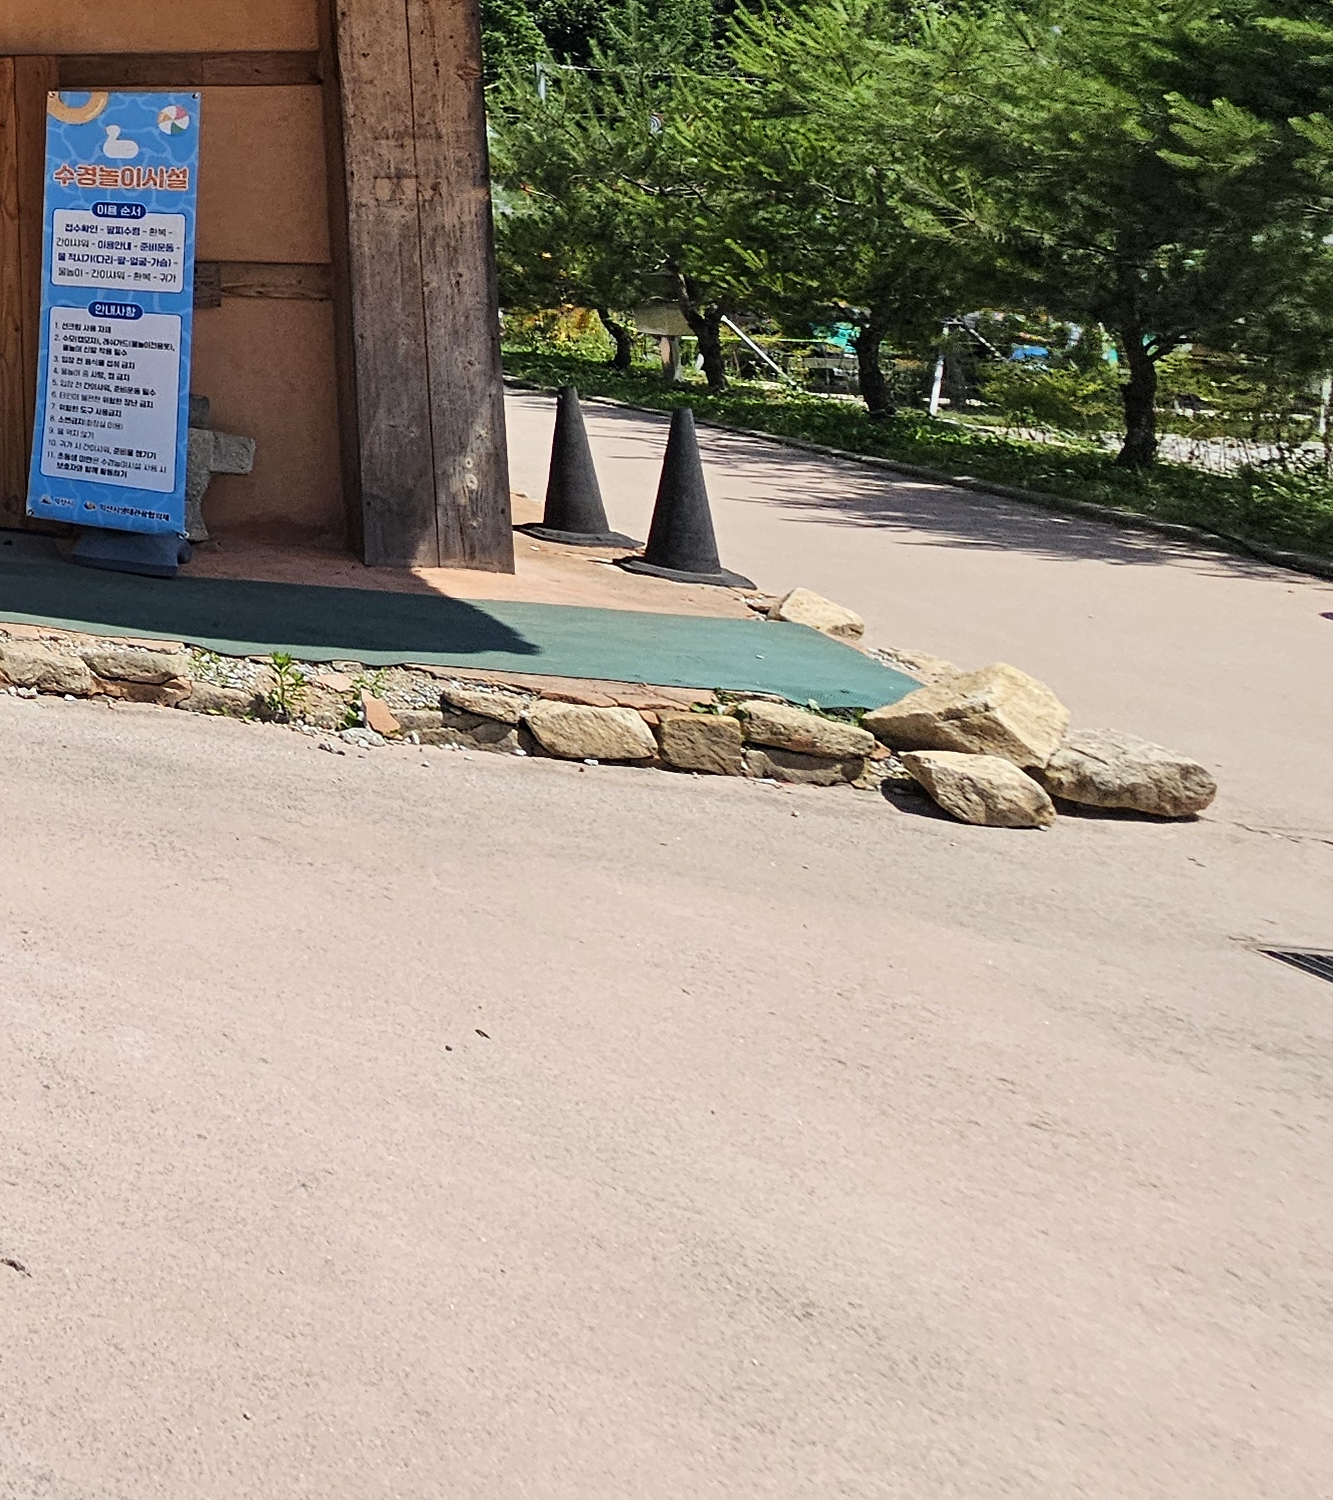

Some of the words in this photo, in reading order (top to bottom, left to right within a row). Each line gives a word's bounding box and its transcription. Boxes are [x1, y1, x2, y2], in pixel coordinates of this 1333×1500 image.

[54, 164, 188, 191] 수경놀이시설
[97, 204, 117, 215] 이용
[121, 205, 141, 216] 순서
[65, 223, 98, 233] 접수확인
[149, 227, 166, 237] 환복
[56, 237, 89, 248] 간이샤워
[98, 240, 132, 250] 이용안내
[140, 242, 174, 252] 준비운동
[58, 267, 83, 277] 물놀이
[91, 269, 125, 280] 간이샤워
[134, 272, 151, 281] 환복
[159, 273, 176, 283] 귀가
[95, 303, 136, 318] 안내사항
